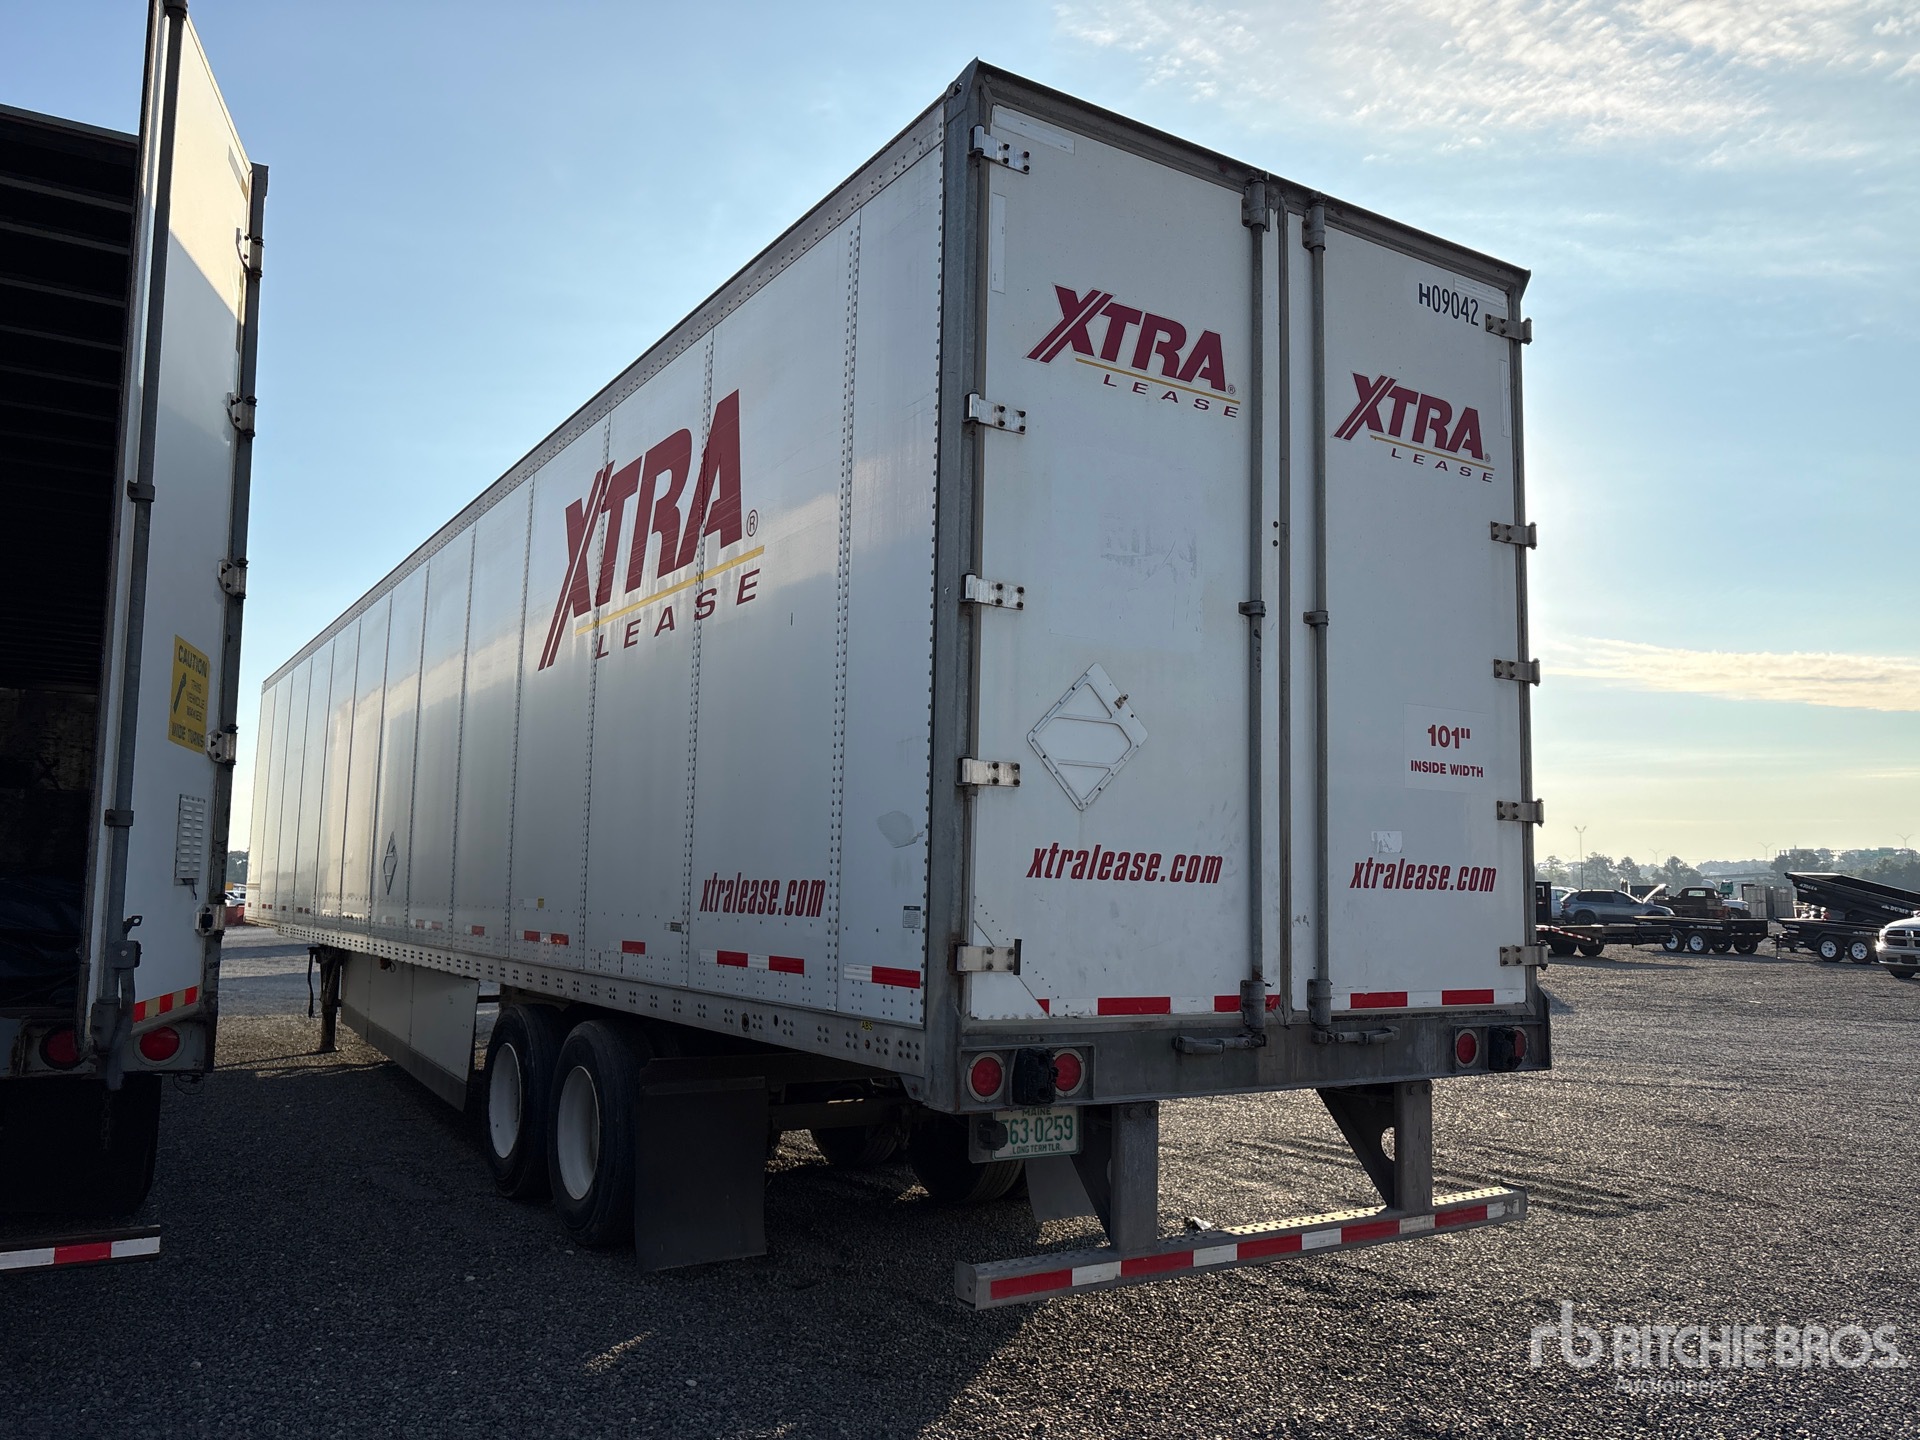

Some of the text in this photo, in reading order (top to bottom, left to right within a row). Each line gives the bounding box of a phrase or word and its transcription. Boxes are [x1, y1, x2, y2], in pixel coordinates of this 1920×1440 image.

[1418, 282, 1480, 327] H09042
[1026, 284, 1227, 392] XTRA
[1102, 373, 1240, 419] LEASE
[1333, 372, 1485, 461] XTRA
[1390, 447, 1494, 483] LEASE
[538, 388, 743, 672] XTRA
[595, 567, 761, 660] LEASE
[178, 645, 208, 678] CAUTION
[171, 721, 205, 749] WIDE TURNS
[1410, 759, 1485, 779] INSIDE WIDTH
[1026, 841, 1223, 885] xtralease.com
[1350, 855, 1498, 893] xtralease.com
[699, 871, 826, 918] xtralease.com
[1022, 1107, 1052, 1117] MAINE
[1012, 1145, 1030, 1155] LONG
[1030, 1144, 1047, 1153] TERM
